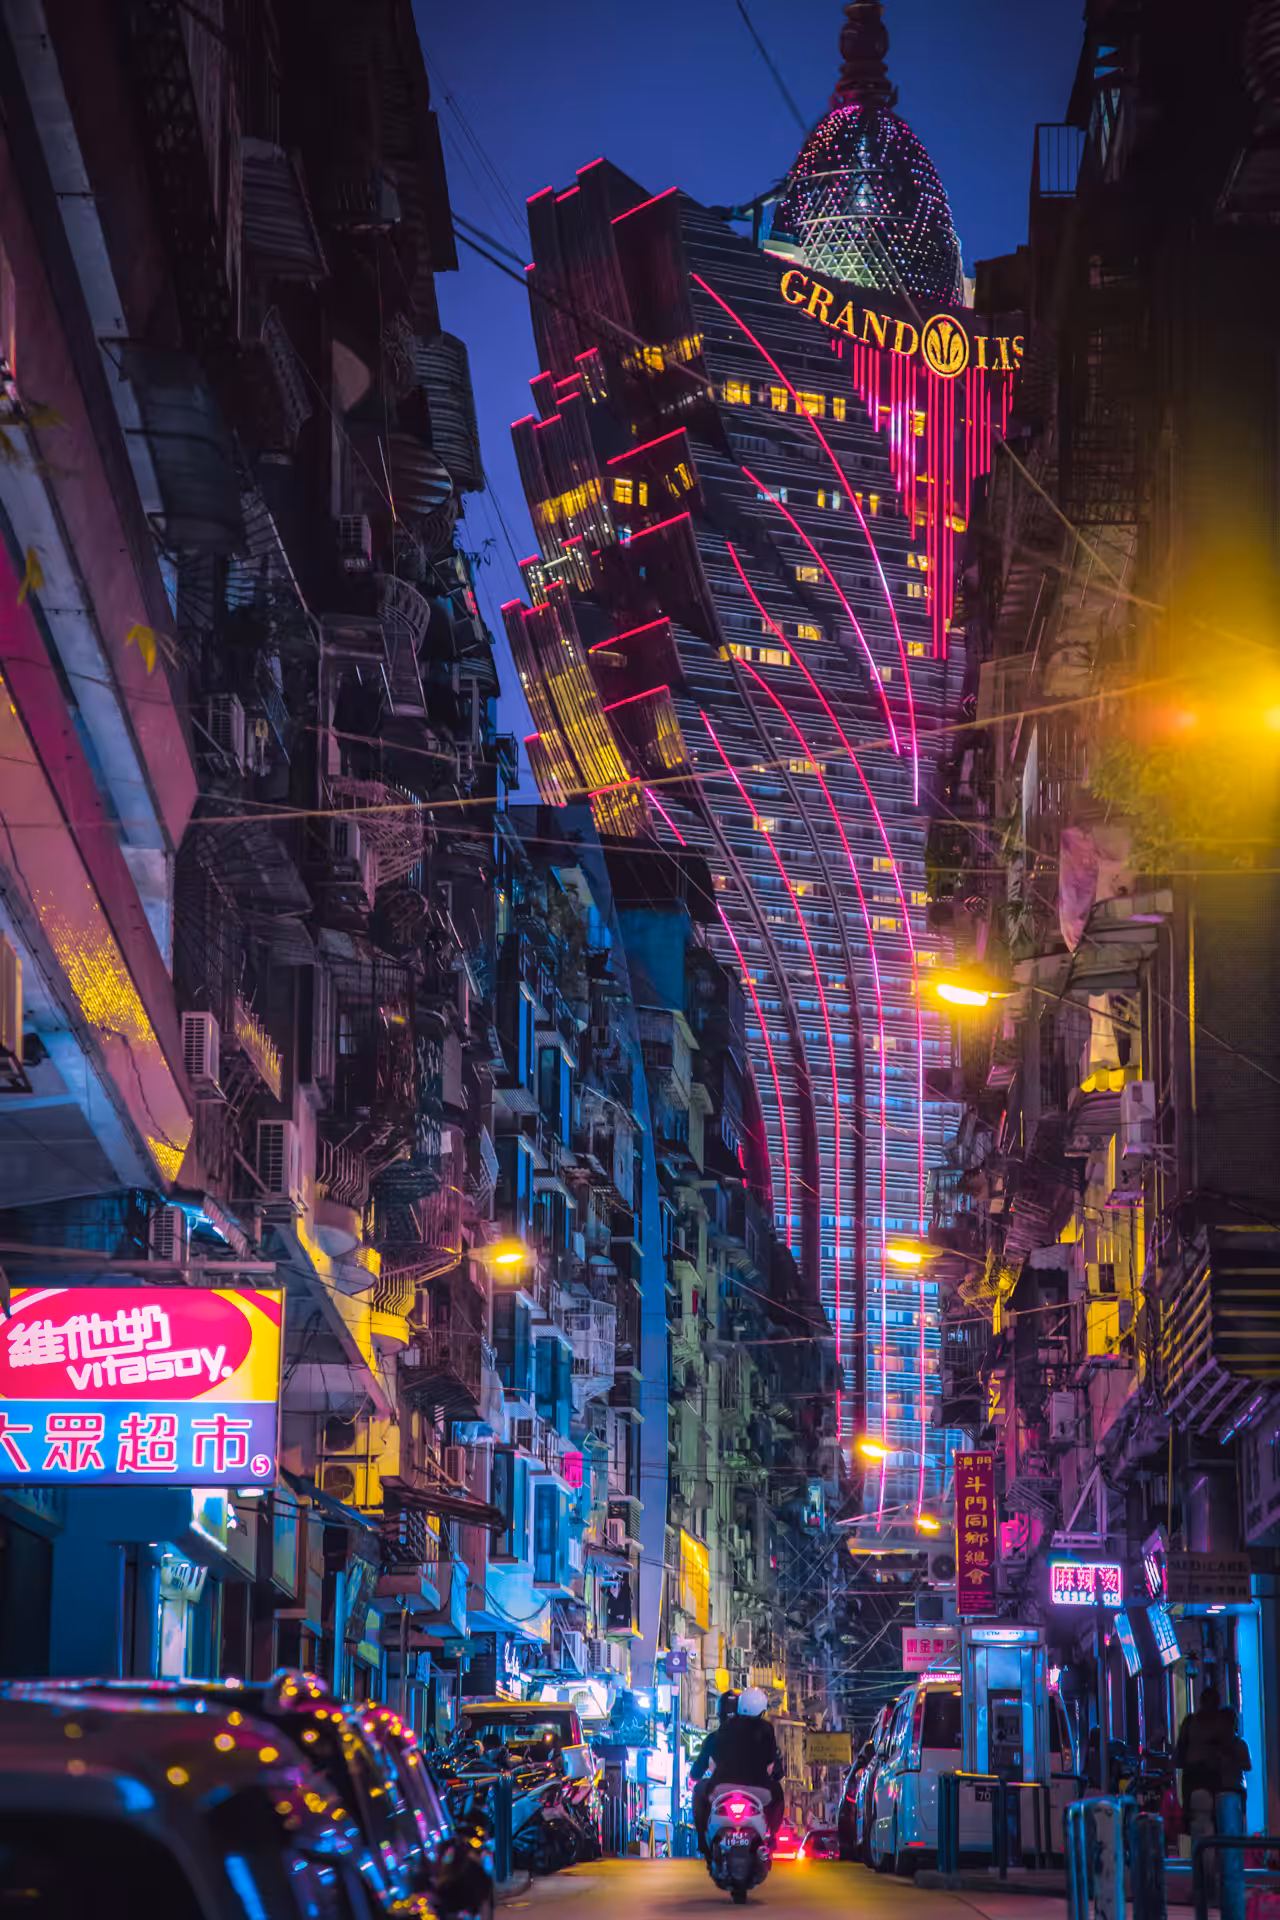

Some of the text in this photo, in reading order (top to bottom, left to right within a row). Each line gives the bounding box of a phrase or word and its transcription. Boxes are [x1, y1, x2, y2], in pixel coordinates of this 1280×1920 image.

[780, 269, 919, 357] GRAND
[7, 1304, 171, 1368] 維他奶
